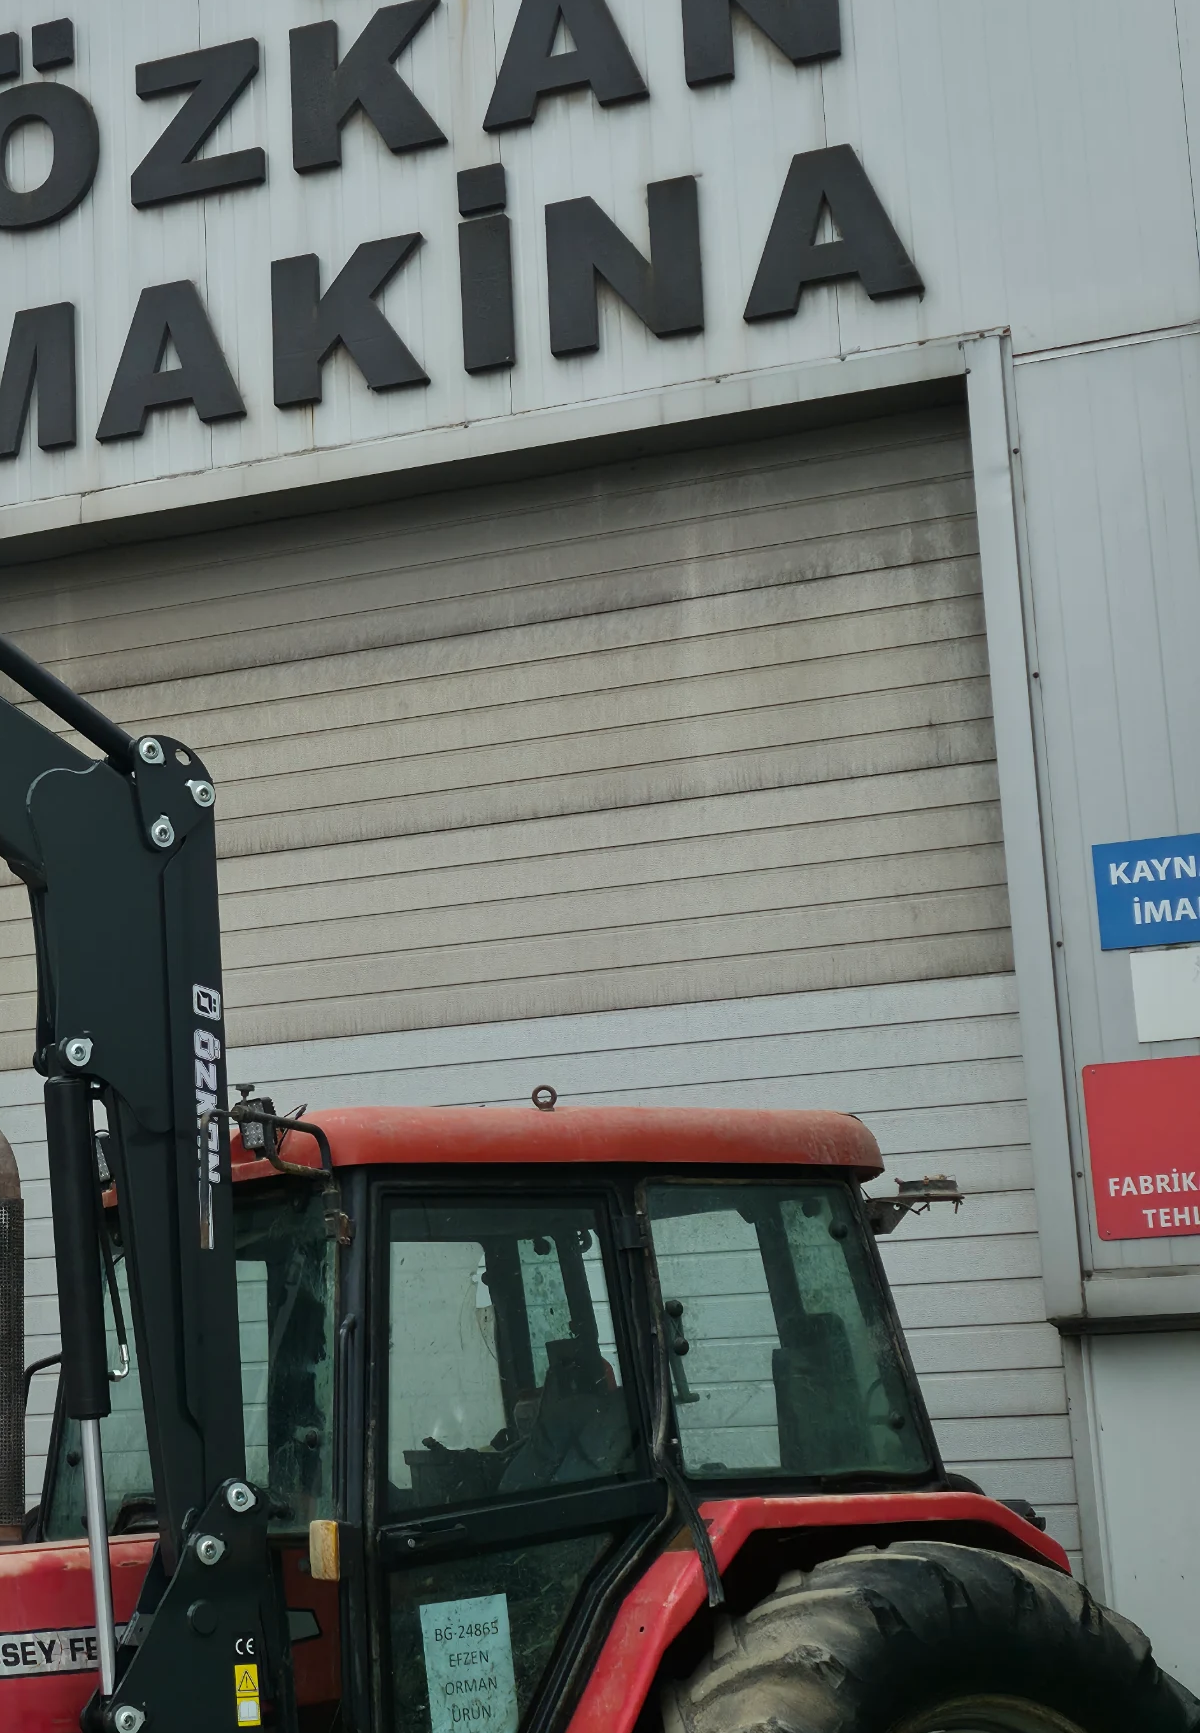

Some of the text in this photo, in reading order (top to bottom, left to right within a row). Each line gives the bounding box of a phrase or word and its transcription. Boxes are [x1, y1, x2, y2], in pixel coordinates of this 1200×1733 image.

[1109, 855, 1200, 885] KAYN
[1133, 896, 1200, 925] İMA
[1109, 1168, 1200, 1197] FABRİK
[69, 1636, 99, 1662] FE
[449, 1650, 489, 1668] EFZEN
[445, 1676, 498, 1696] ORMAN
